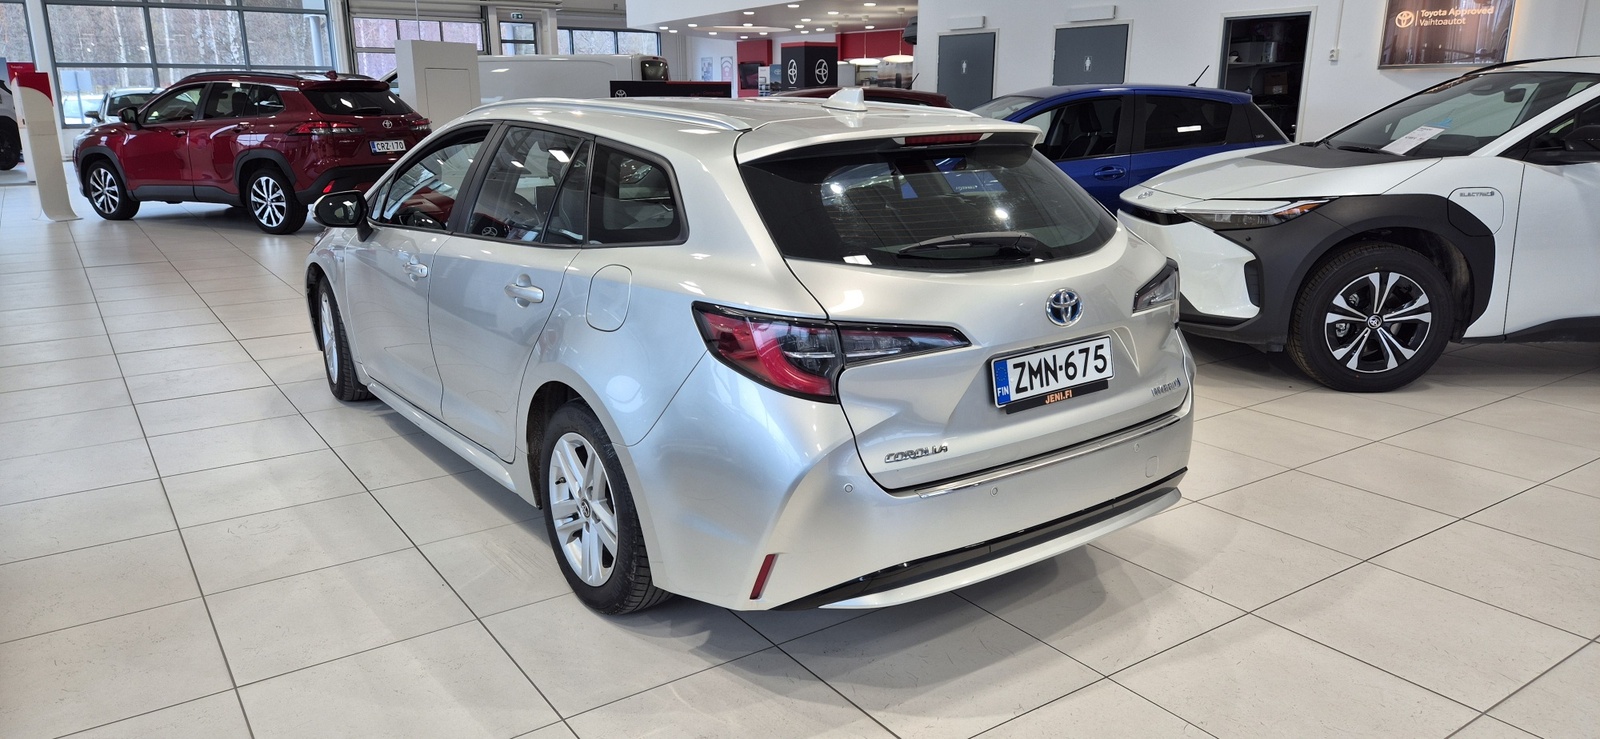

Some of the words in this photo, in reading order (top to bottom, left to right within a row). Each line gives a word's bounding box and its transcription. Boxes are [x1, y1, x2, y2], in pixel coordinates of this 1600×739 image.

[1420, 9, 1447, 18] Toyota
[1448, 6, 1495, 17] Approved
[1419, 17, 1466, 27] Vaihtoautot
[376, 141, 404, 151] CRZ-170
[1012, 344, 1108, 394] ZMN-675
[997, 385, 1010, 397] FIN
[1045, 389, 1073, 404] JENI.FI
